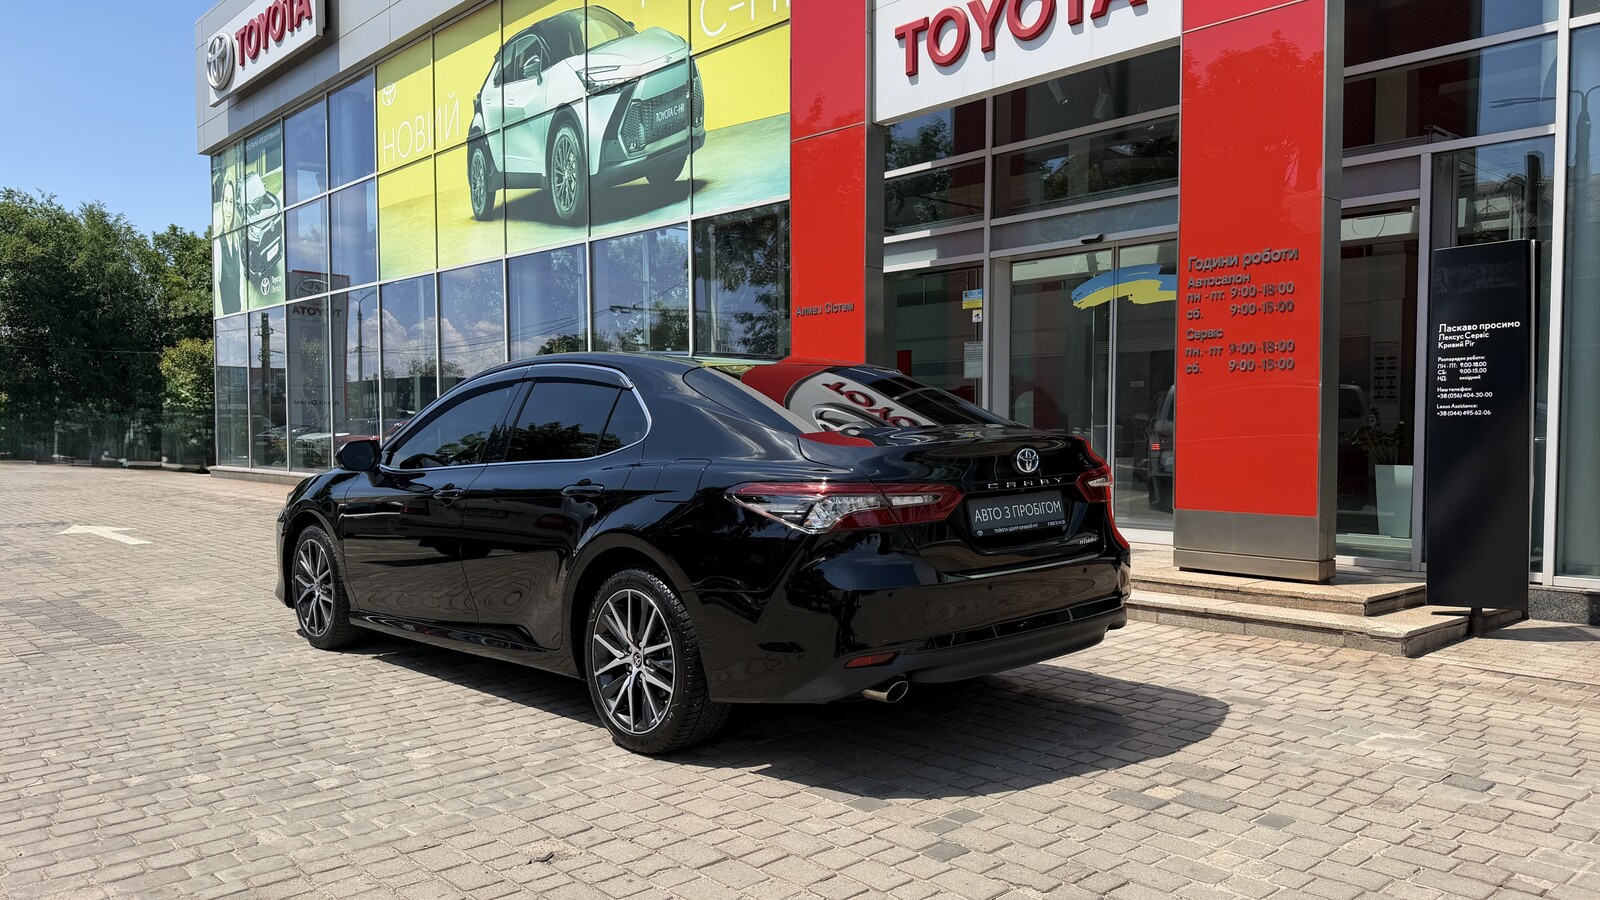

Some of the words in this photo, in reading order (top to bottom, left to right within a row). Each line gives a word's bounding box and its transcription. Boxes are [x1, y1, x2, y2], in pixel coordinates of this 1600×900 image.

[235, 0, 313, 67] TOYOTA
[656, 107, 673, 122] TOYOTA
[673, 103, 685, 116] C-HR
[382, 90, 459, 166] НОВИЙ
[1188, 255, 1239, 272] Години
[1243, 248, 1299, 270] роботи
[1188, 274, 1251, 289] Автосалон
[796, 306, 822, 317] Алмаз
[824, 302, 854, 314] Сістем
[1186, 308, 1204, 320] сб.
[1439, 323, 1478, 333] Ласкаво
[1479, 321, 1521, 331] просимо
[1186, 328, 1224, 343] Сервіс
[1438, 333, 1464, 341] Лексус
[1464, 331, 1490, 339] Сервіс
[1438, 341, 1464, 350] Кривий
[1185, 362, 1203, 374] сб.
[987, 477, 1062, 490] CAMRY
[975, 507, 1002, 522] АВТО
[1012, 500, 1062, 518] ПРОБІГОМ
